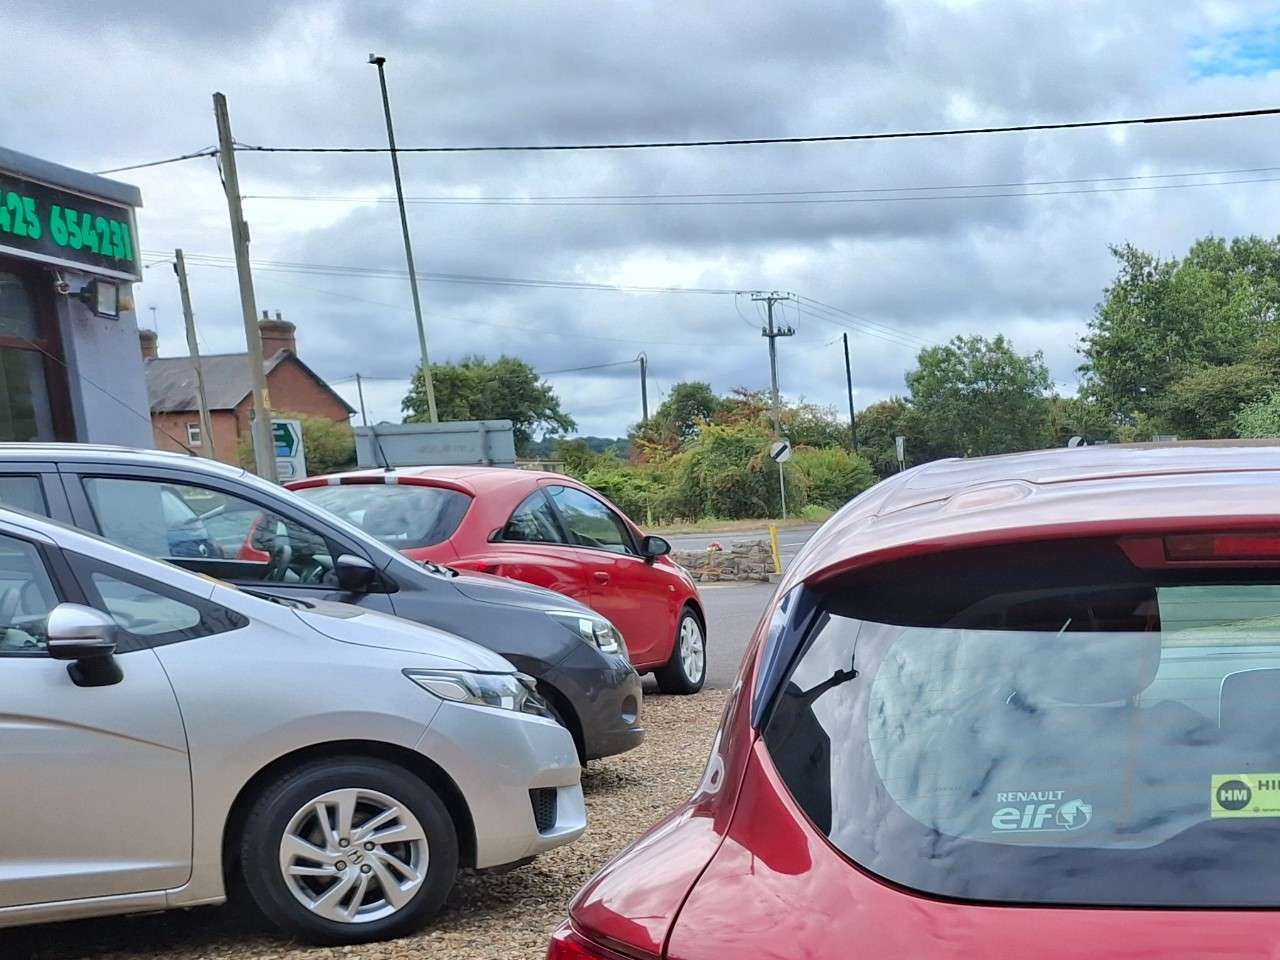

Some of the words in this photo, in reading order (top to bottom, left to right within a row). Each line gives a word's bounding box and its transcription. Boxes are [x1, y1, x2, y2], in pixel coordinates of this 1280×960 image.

[50, 204, 134, 262] 654231
[996, 790, 1065, 803] RENAULT
[1220, 788, 1249, 802] HM
[992, 803, 1056, 830] elf
